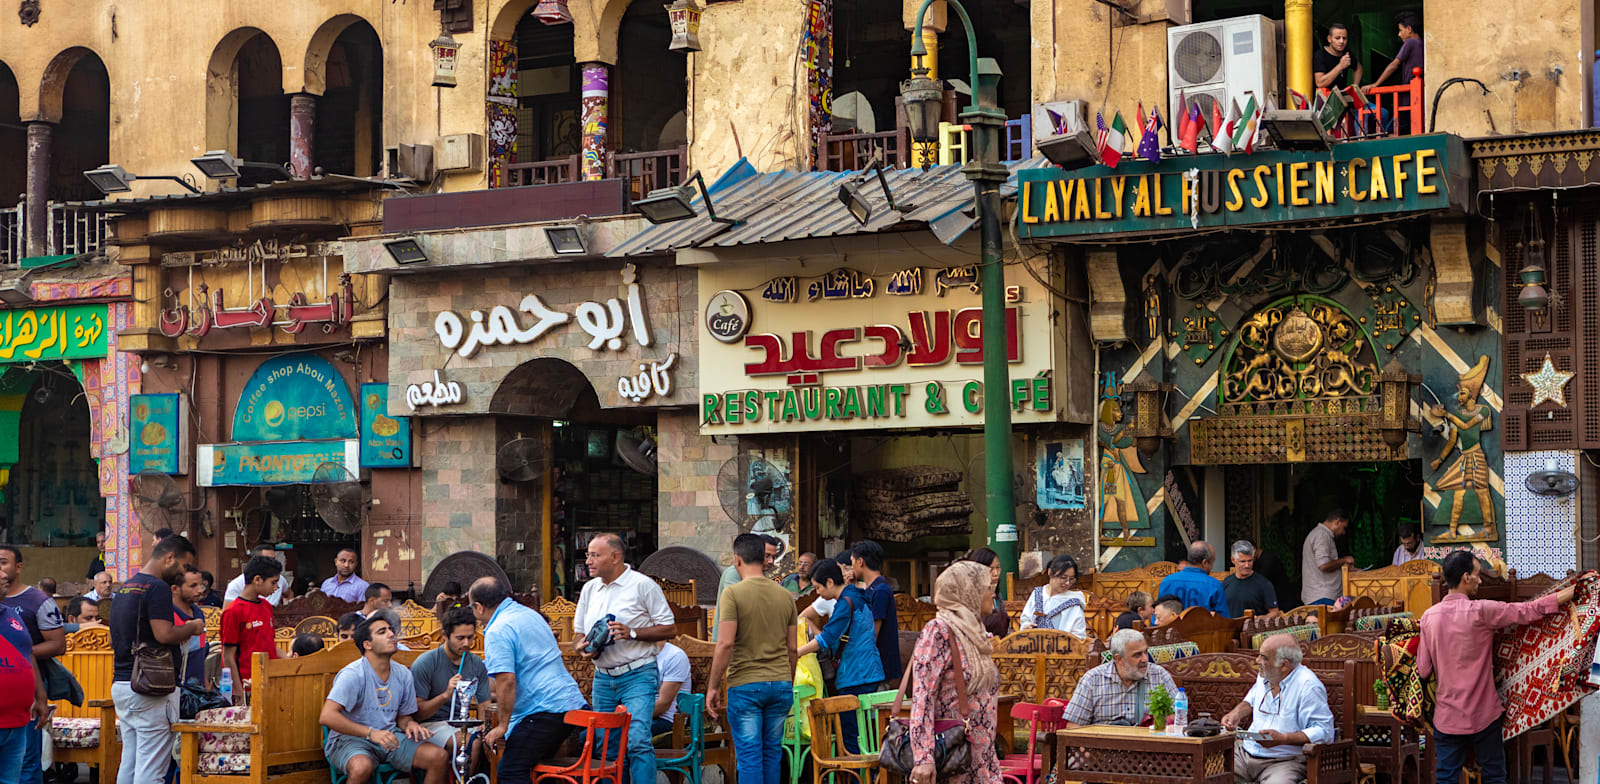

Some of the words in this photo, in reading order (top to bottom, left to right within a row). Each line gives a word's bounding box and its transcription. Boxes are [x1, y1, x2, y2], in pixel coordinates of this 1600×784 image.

[1022, 176, 1125, 223] LAYALY
[1136, 172, 1172, 216] AL
[1349, 148, 1437, 202] CAFE
[761, 276, 797, 303] الله
[886, 266, 922, 296] الله
[934, 265, 979, 297] بسم
[74, 312, 103, 348] قهوة
[159, 287, 276, 338] مازن
[713, 318, 740, 336] Café
[744, 326, 861, 386] عيد
[243, 384, 267, 423] Coffee
[267, 365, 293, 384] shop
[296, 362, 324, 382] Abou
[325, 379, 347, 420] Mazen
[406, 369, 463, 411] مطعم
[617, 352, 676, 402] كافيه
[287, 402, 326, 421] pepsi
[703, 384, 908, 424] RESTAURANT
[924, 380, 946, 415] &
[962, 370, 1052, 414] CFÉ
[1424, 546, 1504, 561] 欢迎埃及
